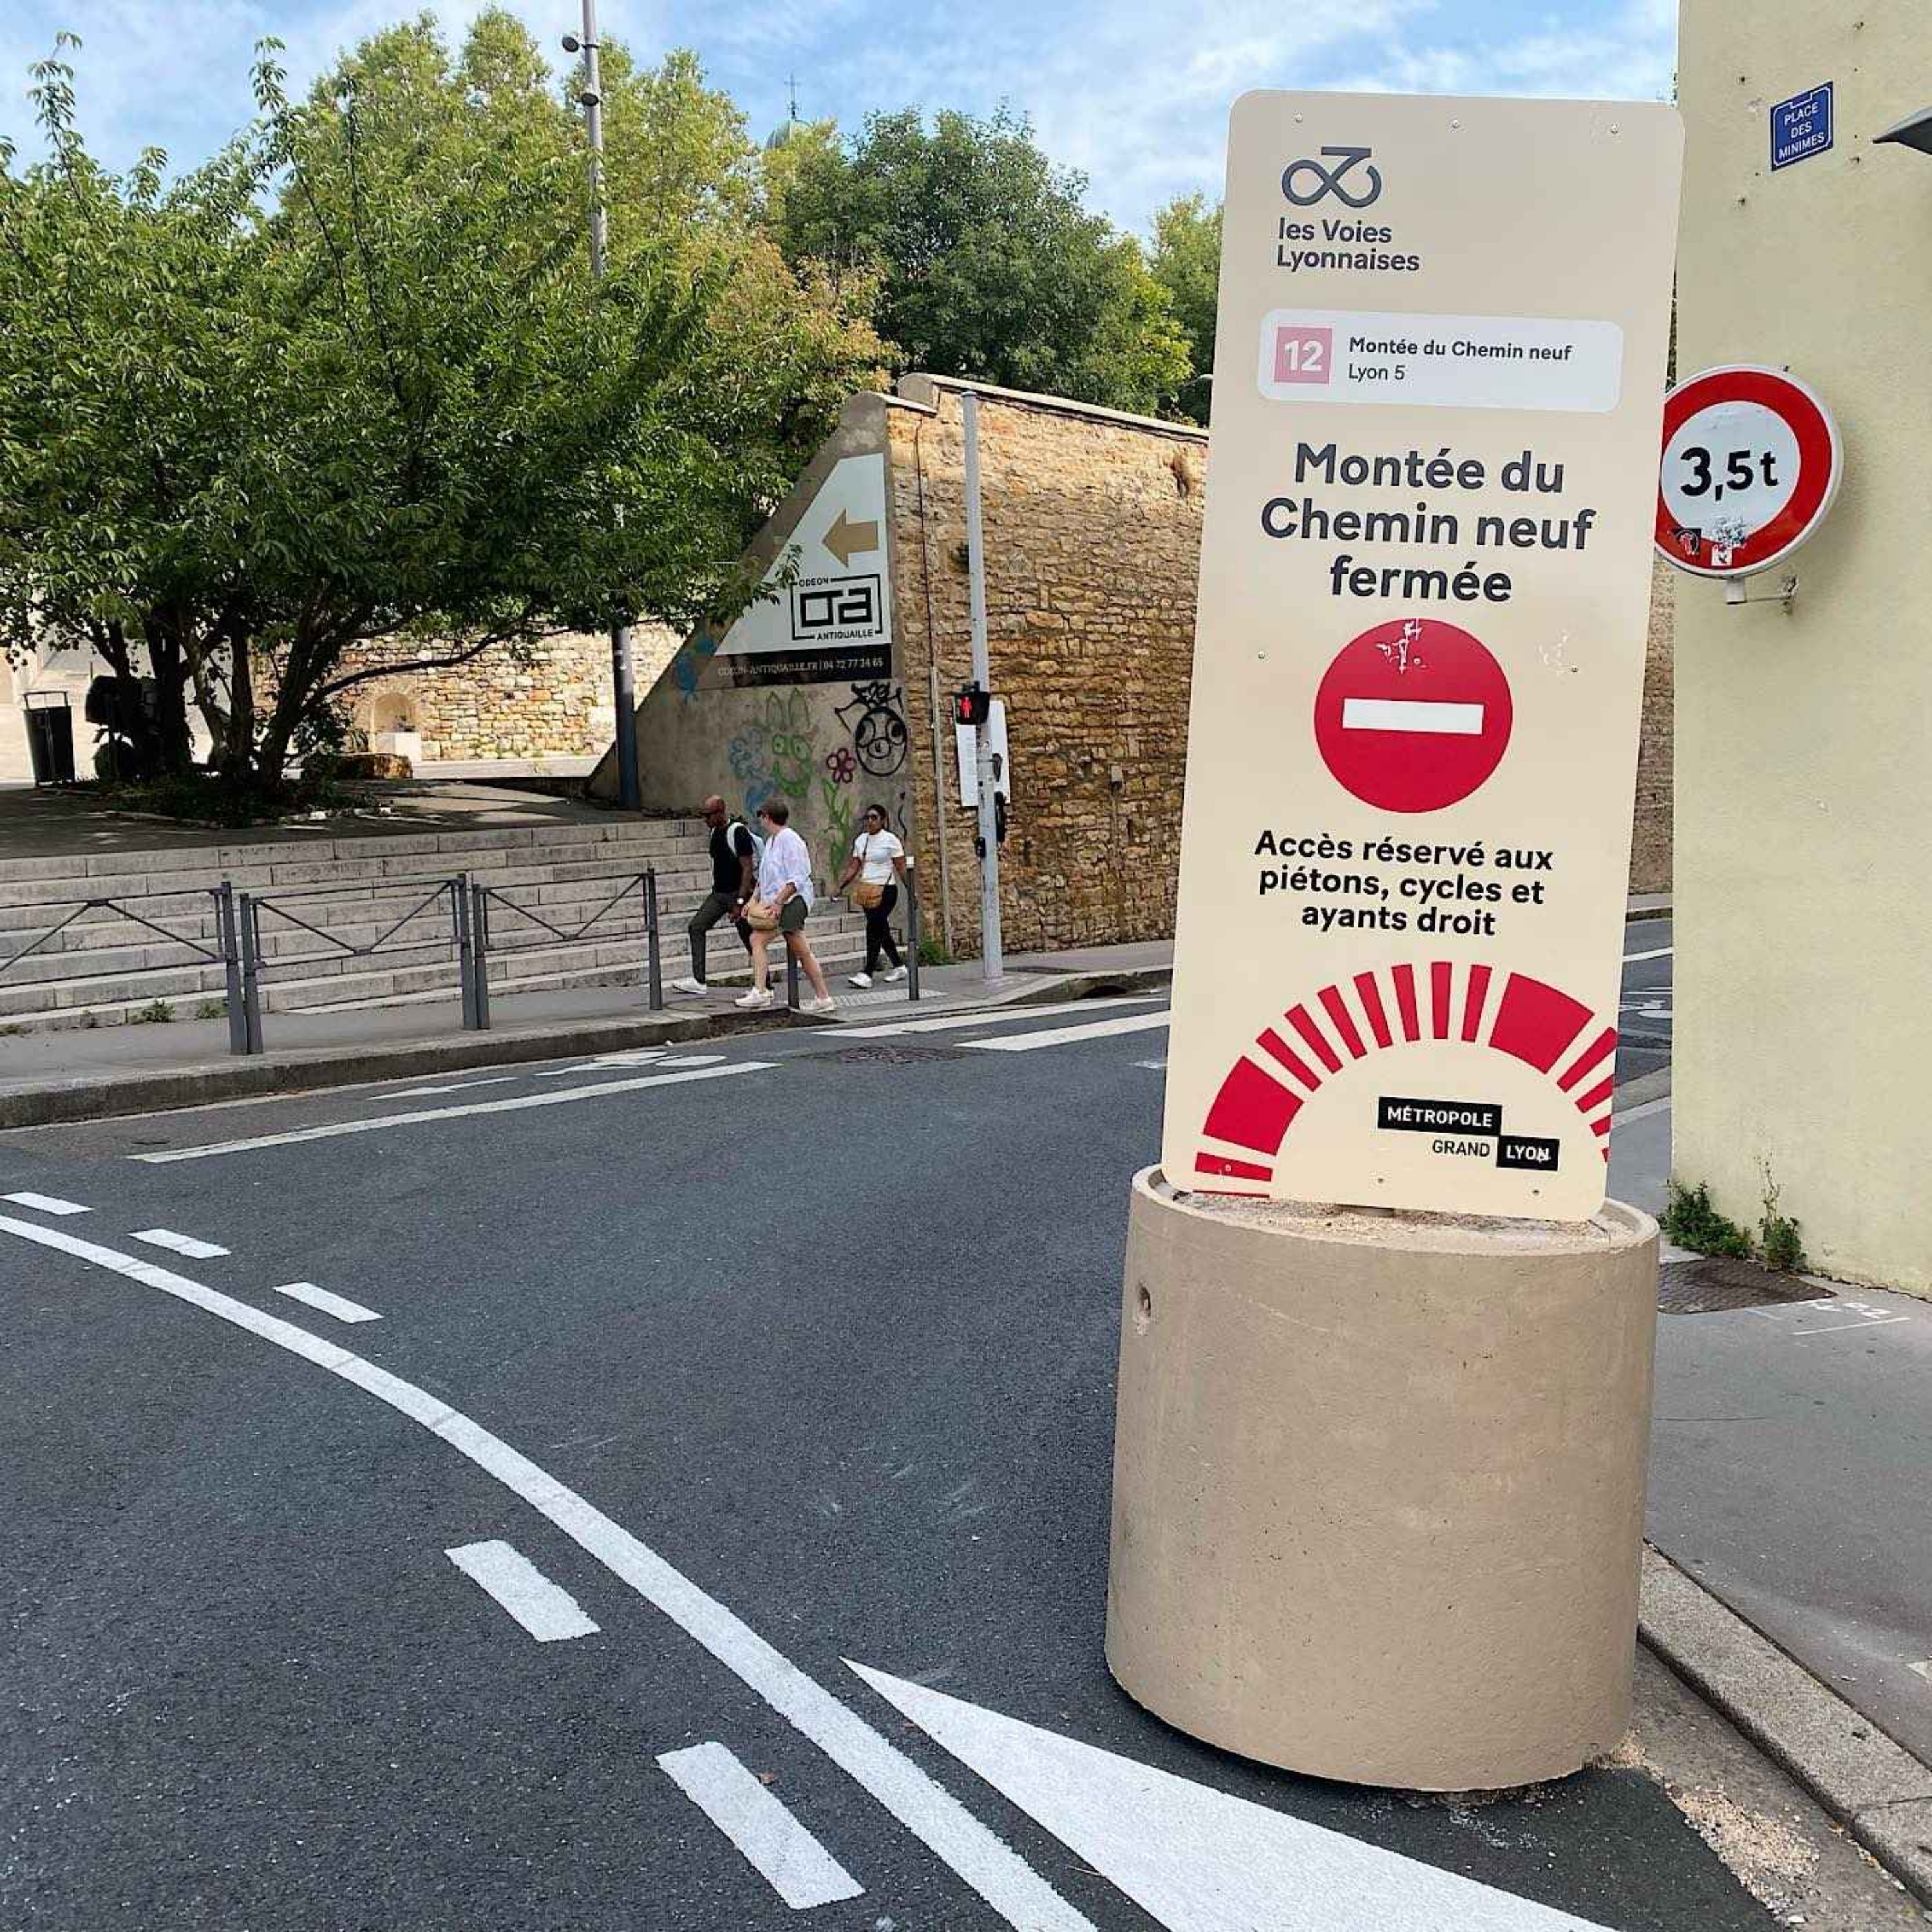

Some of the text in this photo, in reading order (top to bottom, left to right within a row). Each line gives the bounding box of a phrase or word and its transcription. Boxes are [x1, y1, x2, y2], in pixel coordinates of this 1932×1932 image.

[1783, 102, 1819, 126] PLACE
[1791, 121, 1812, 138] DES
[1779, 131, 1825, 160] MINIMES
[1278, 216, 1392, 243] les Voies
[1277, 244, 1420, 273] Lyonnaises
[1284, 340, 1323, 372] 12
[1349, 337, 1573, 361] Montée du Chemin neuf
[1349, 363, 1406, 383] Lyon 5
[1295, 442, 1564, 493] Montée du
[1261, 497, 1597, 550] Chemin neuf
[799, 577, 829, 587] ODEON
[1329, 554, 1512, 603] fermée
[817, 629, 873, 641] ANTIQUAILLE
[1254, 830, 1553, 871] Accès réservé aux
[1259, 863, 1545, 905] piétons, cycles et
[1302, 905, 1496, 936] ayants droit
[1387, 1104, 1493, 1128] MÉTROPOLE
[1432, 1139, 1551, 1163] GRAND LYON
